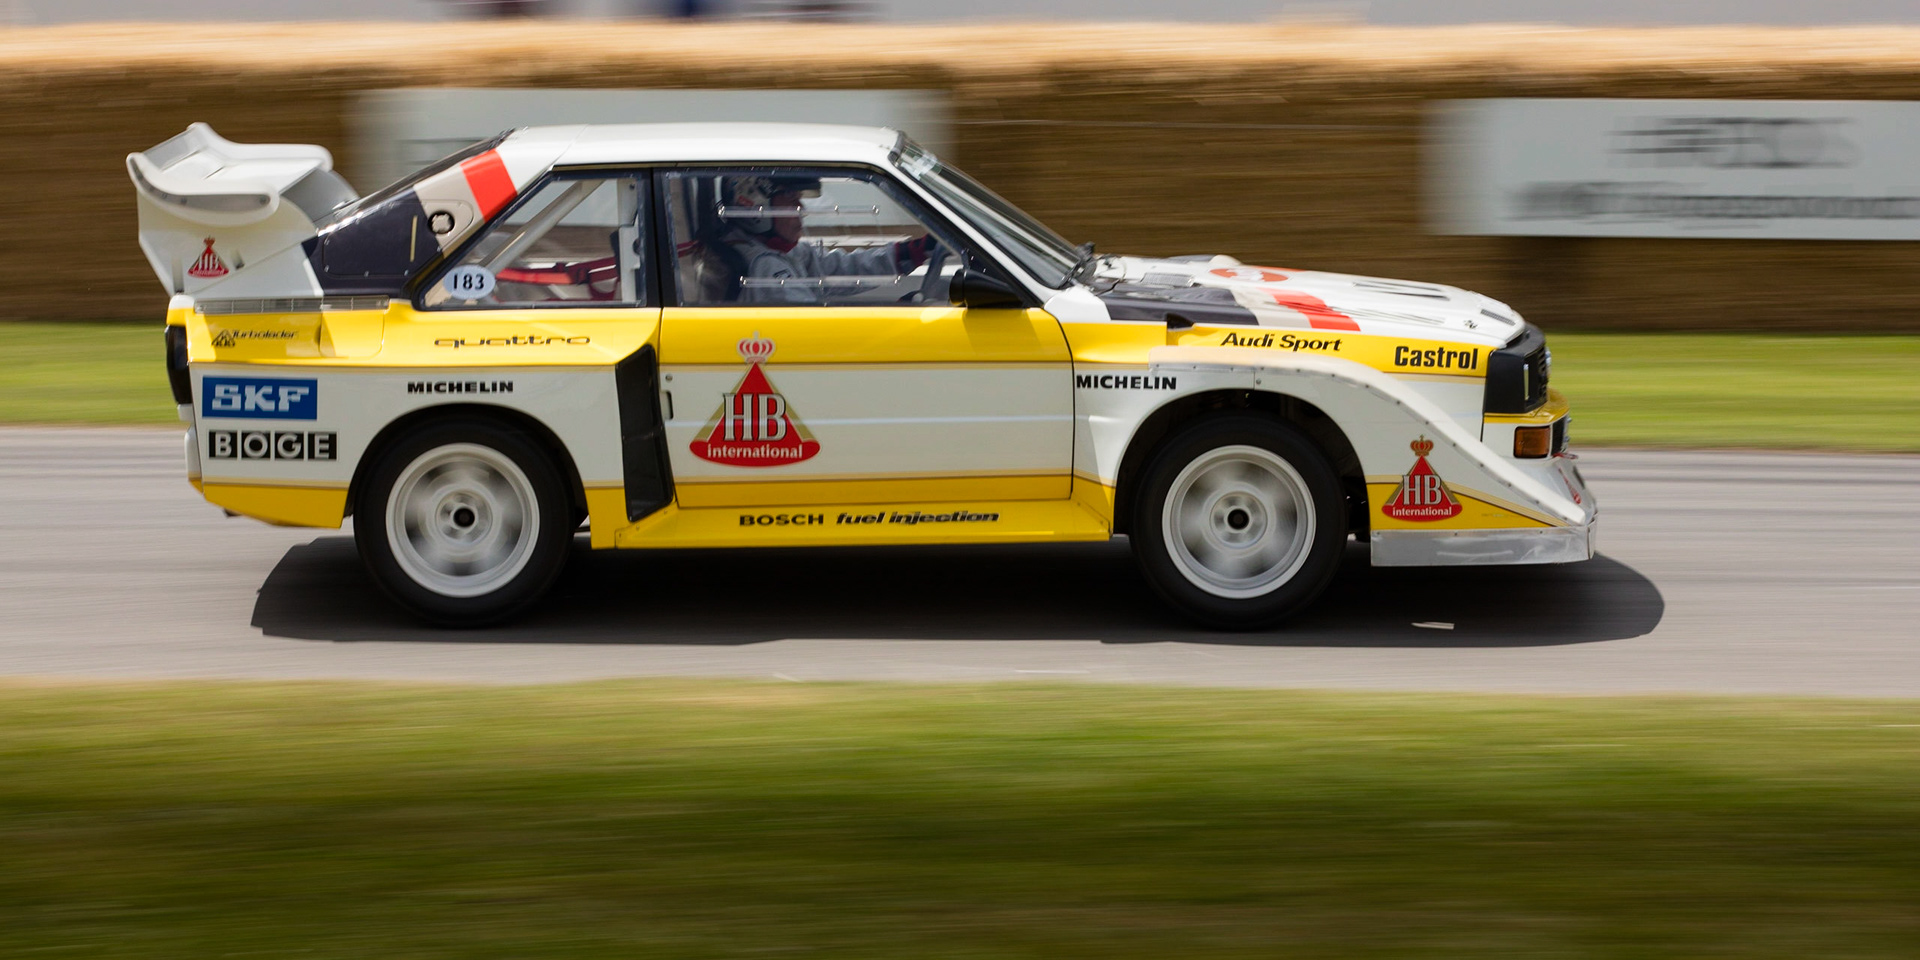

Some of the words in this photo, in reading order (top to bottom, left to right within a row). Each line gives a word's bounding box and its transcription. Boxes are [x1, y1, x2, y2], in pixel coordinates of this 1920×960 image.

[453, 274, 485, 290] 183
[434, 335, 590, 348] quattro
[1221, 332, 1275, 348] Audi
[1278, 334, 1343, 352] Sport
[1395, 346, 1478, 370] Castrol
[407, 381, 514, 394] MICHELIN
[1076, 374, 1177, 391] MICHELIN
[212, 384, 310, 412] SKF
[722, 393, 787, 441] HB
[214, 431, 332, 459] BOGE
[707, 443, 803, 459] international
[1402, 474, 1442, 505] HB
[739, 514, 824, 526] BOSCH
[836, 511, 885, 525] fuel
[888, 510, 1000, 526] injection
[1392, 506, 1452, 516] international
